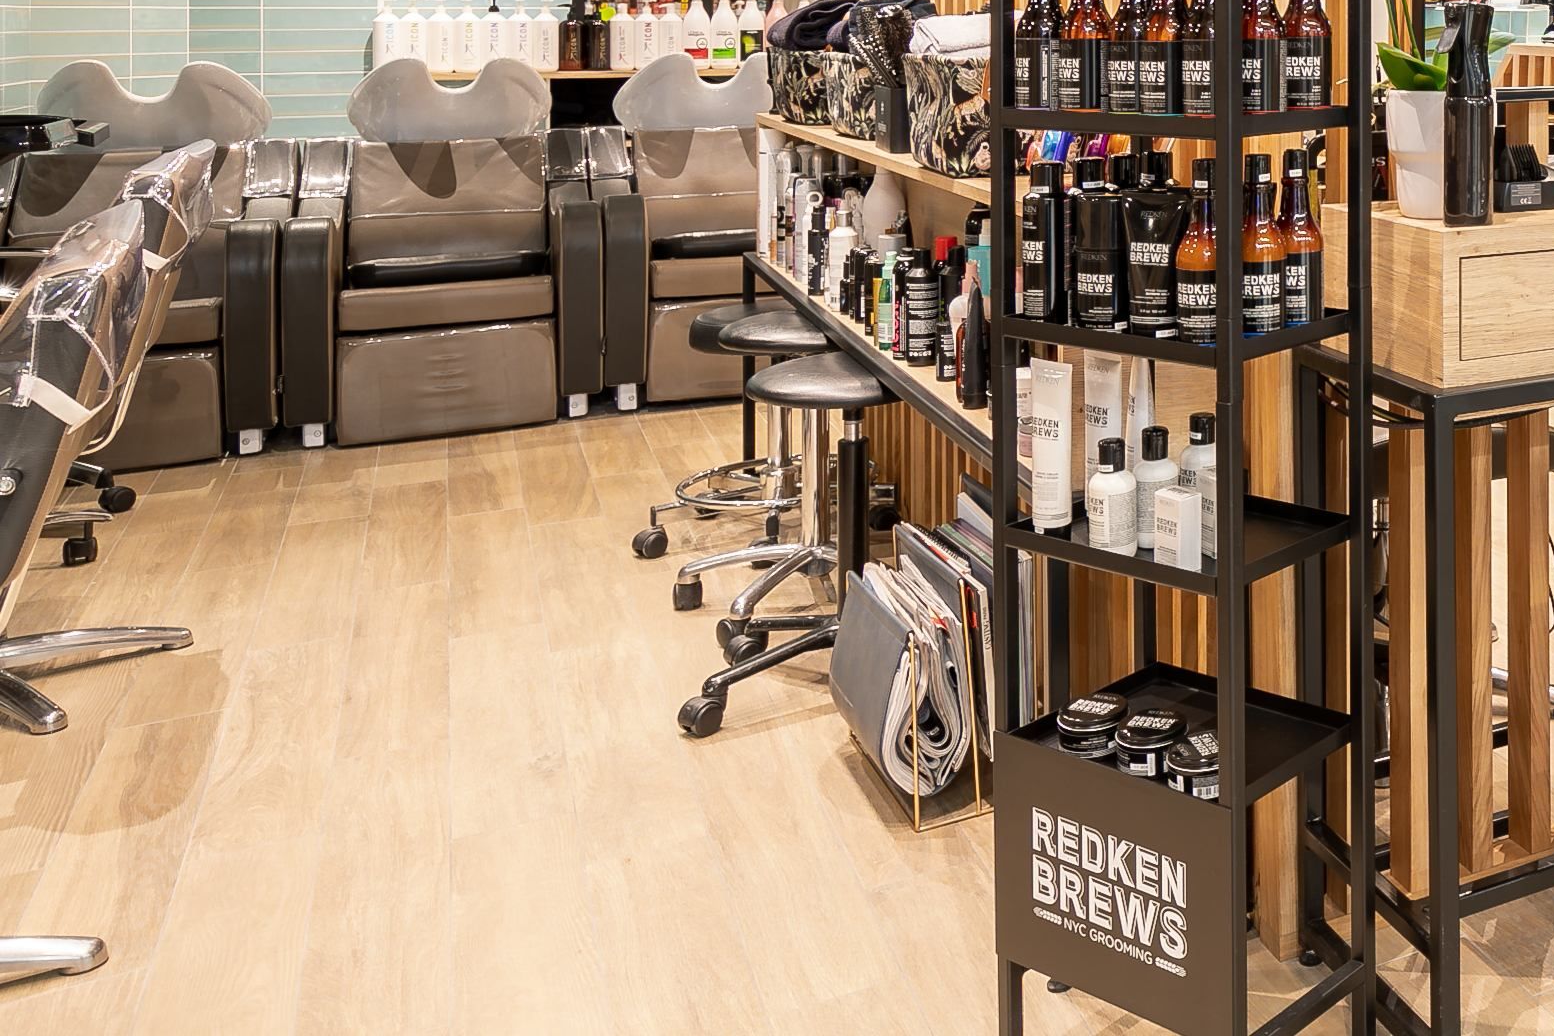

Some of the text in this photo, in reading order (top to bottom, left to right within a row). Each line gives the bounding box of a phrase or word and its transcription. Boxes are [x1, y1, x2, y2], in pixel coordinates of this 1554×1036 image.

[1182, 60, 1210, 71] EDKEN
[1286, 56, 1320, 66] EDKEN
[1286, 66, 1320, 76] REWS
[1131, 242, 1169, 253] REDKEN
[1130, 251, 1169, 263] BREWS
[1078, 273, 1112, 283] REDKEN
[1244, 273, 1280, 285] EDKEN
[1078, 282, 1112, 293] BREWS
[1178, 283, 1216, 295] REDKEN
[1244, 284, 1280, 296] REWS
[1178, 293, 1216, 305] BREWS
[1086, 404, 1109, 416] EDKEN
[1032, 426, 1059, 438] REWS
[1073, 698, 1117, 710] REDKEN
[1127, 720, 1172, 731] BREWS
[1132, 715, 1177, 725] REDKEN
[1032, 806, 1187, 908] REDKEN
[1032, 853, 1188, 960] BREWS
[1063, 916, 1153, 965] NYC GROOMING
